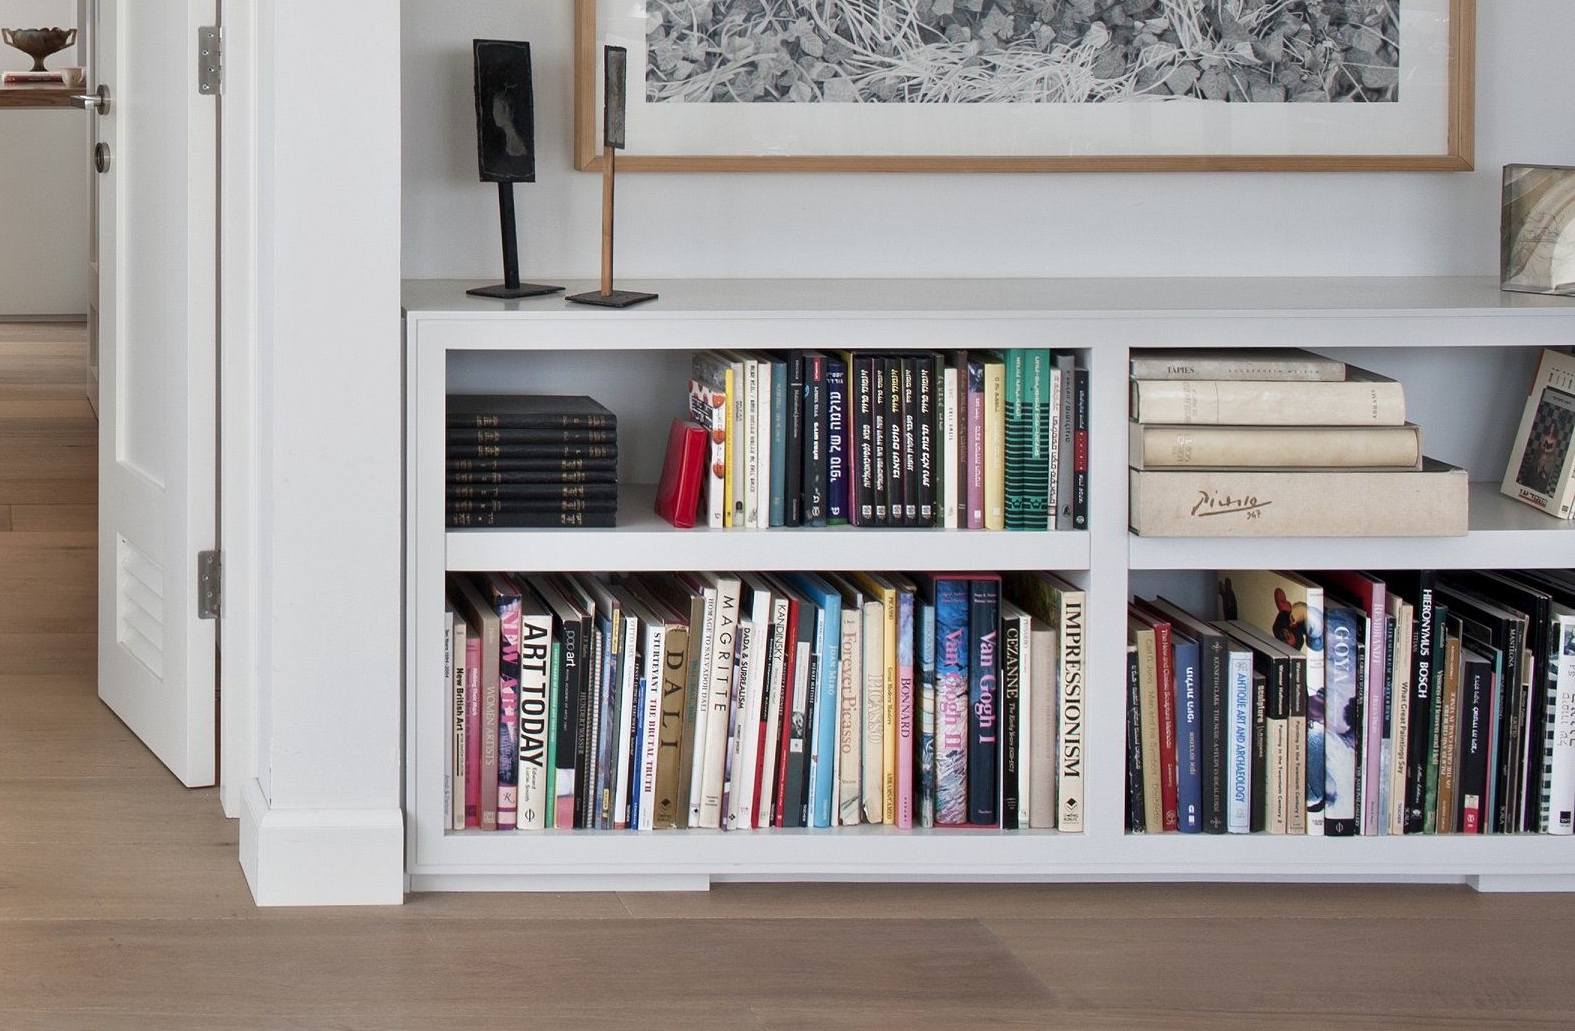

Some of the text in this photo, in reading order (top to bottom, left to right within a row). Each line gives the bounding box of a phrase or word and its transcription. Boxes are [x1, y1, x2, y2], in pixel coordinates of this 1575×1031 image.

[1167, 366, 1194, 374] TÀPIES
[829, 391, 842, 430] עולמה
[829, 435, 842, 452] של
[830, 457, 841, 483] סופי
[628, 620, 636, 641] OTTO
[714, 595, 735, 712] MAGRITTE
[741, 627, 750, 650] DADA
[773, 604, 786, 661] KANDINSKY
[1145, 639, 1153, 654] Carl
[1334, 626, 1349, 683] GOYA
[1386, 623, 1394, 673] RIJKSMUSEUM
[1418, 589, 1432, 698] HIERONYMUS BOSCH
[456, 668, 464, 686] New
[502, 610, 518, 728] NEW ART
[700, 598, 714, 713] HOMAGE TO SALVADOR DALI
[486, 686, 494, 725] WOMEN
[520, 623, 547, 768] ART TODAY
[660, 650, 684, 749] DALI
[737, 661, 748, 709] SURREALISM
[841, 632, 857, 754] Forever Picasso
[938, 630, 963, 750] Van Gogh II
[975, 630, 995, 744] Van Gogh I
[1064, 602, 1081, 779] IMPRESSIONISM
[1185, 667, 1195, 723] תולדות היופי
[1256, 685, 1264, 723] sculpture
[1436, 670, 1444, 696] Visions
[644, 632, 661, 793] STURTEVANT THE BRUTAL TRUTH
[867, 674, 884, 744] PICASSO
[901, 678, 911, 738] BONNARD
[1434, 705, 1442, 730] Heaven
[486, 728, 494, 765] ARTISTS
[1150, 742, 1158, 776] Symbols
[1235, 673, 1247, 803] ANTIQUE ART AND ARCHAEOLOGY
[1397, 725, 1407, 762] Paintings
[1433, 732, 1441, 747] and
[1397, 763, 1405, 774] Say
[1151, 783, 1160, 825] Doubleday
